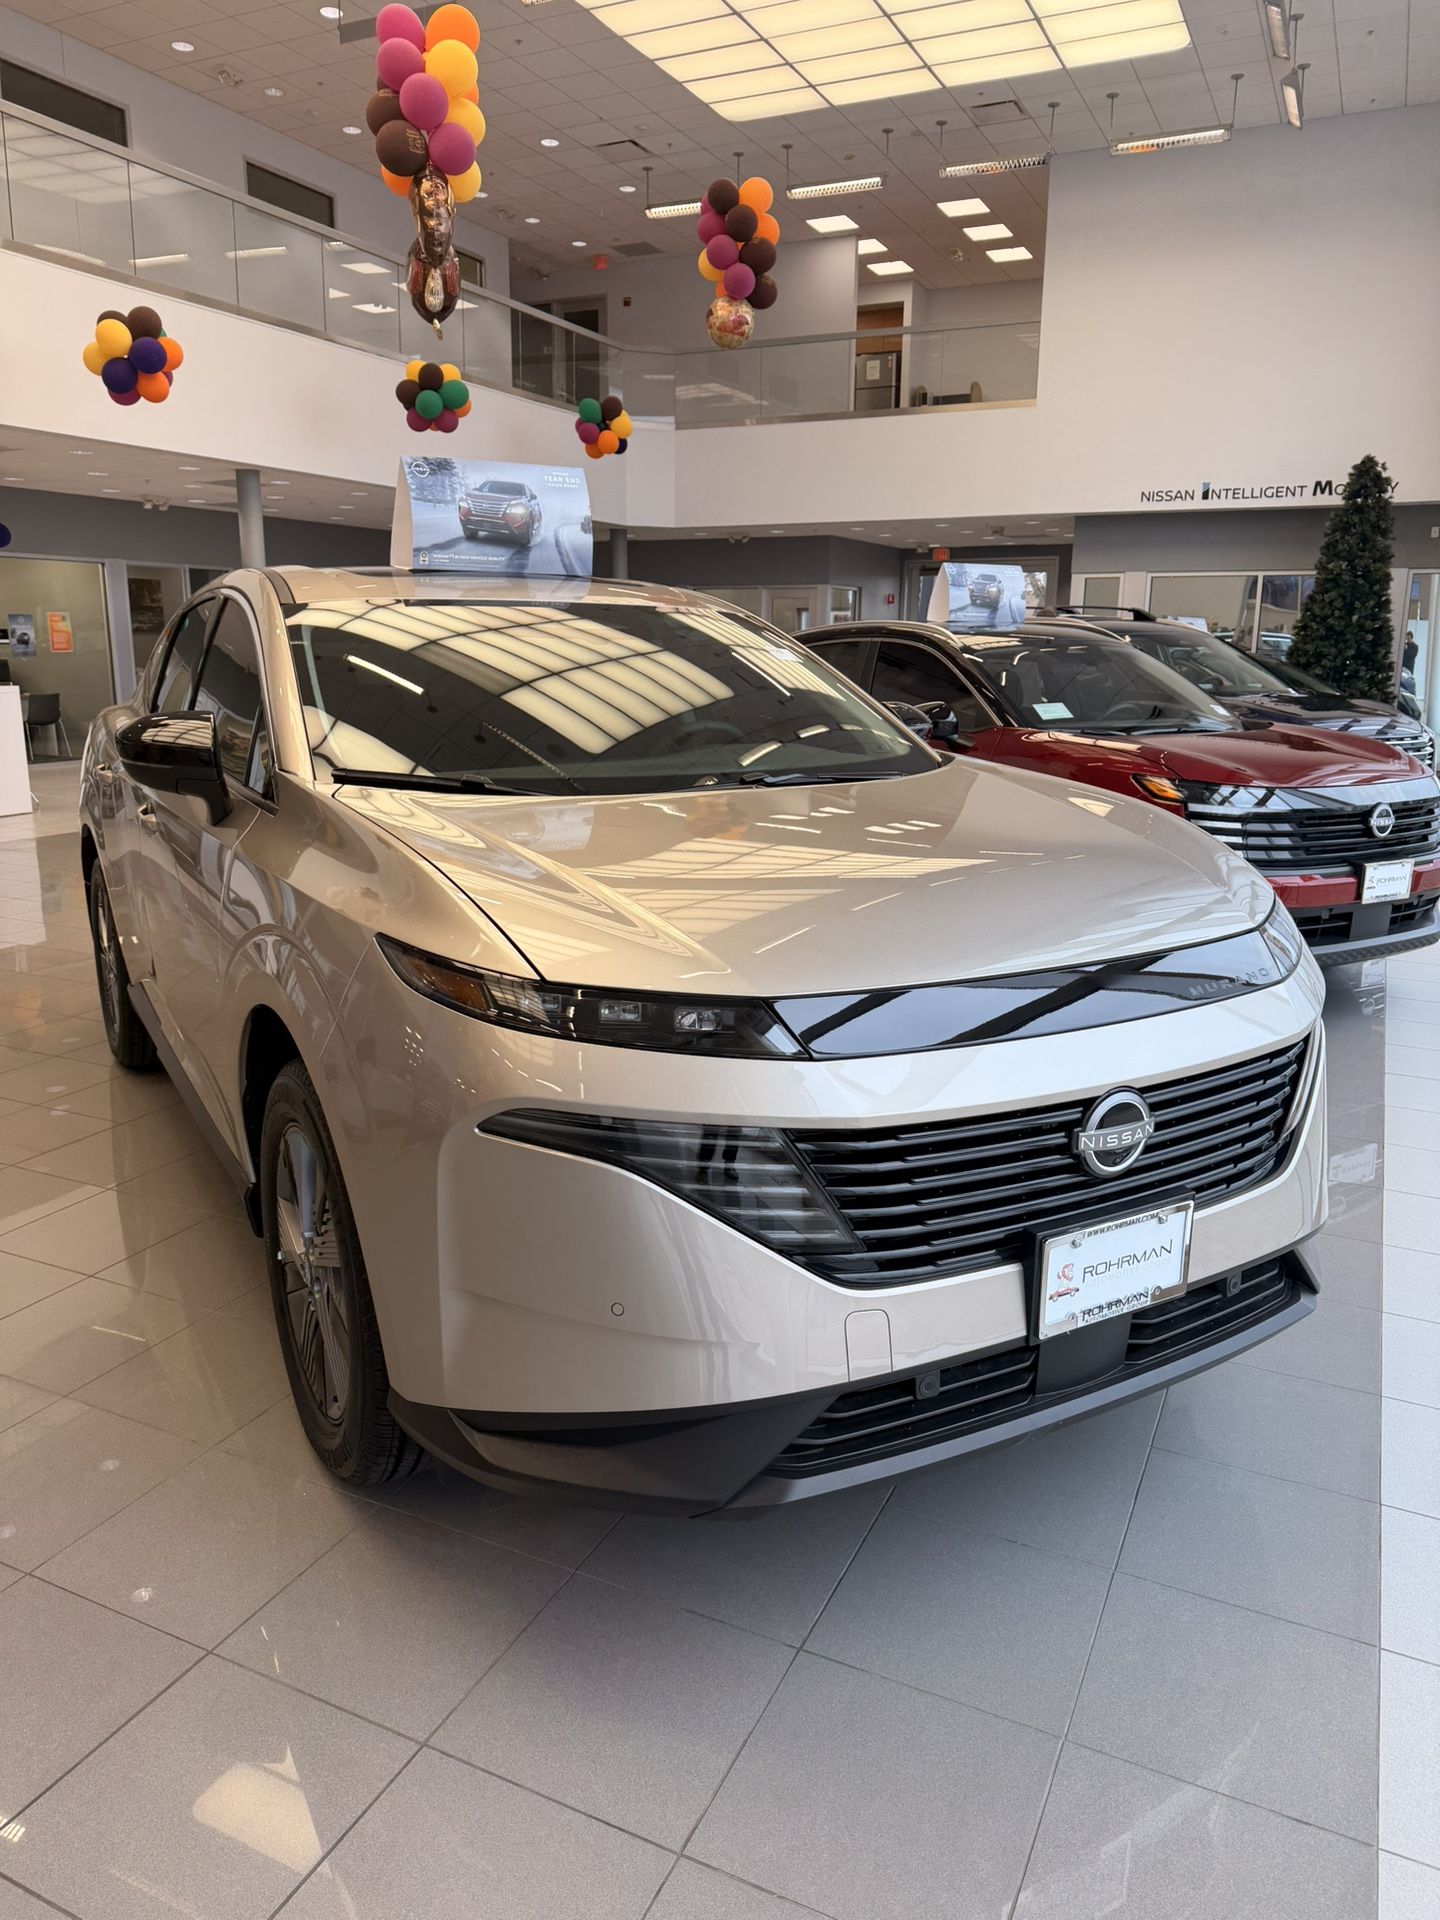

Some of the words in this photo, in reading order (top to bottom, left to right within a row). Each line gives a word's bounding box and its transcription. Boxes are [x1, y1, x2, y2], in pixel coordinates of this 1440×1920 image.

[1140, 489, 1195, 502] NISSAN
[1188, 967, 1270, 997] MURANO
[1081, 1121, 1154, 1149] NISSAN
[1087, 1212, 1160, 1238] WWW.ROHRMAN.COM
[1082, 1239, 1173, 1284] ROHRMAN
[1082, 1288, 1149, 1322] ROHRMAN
